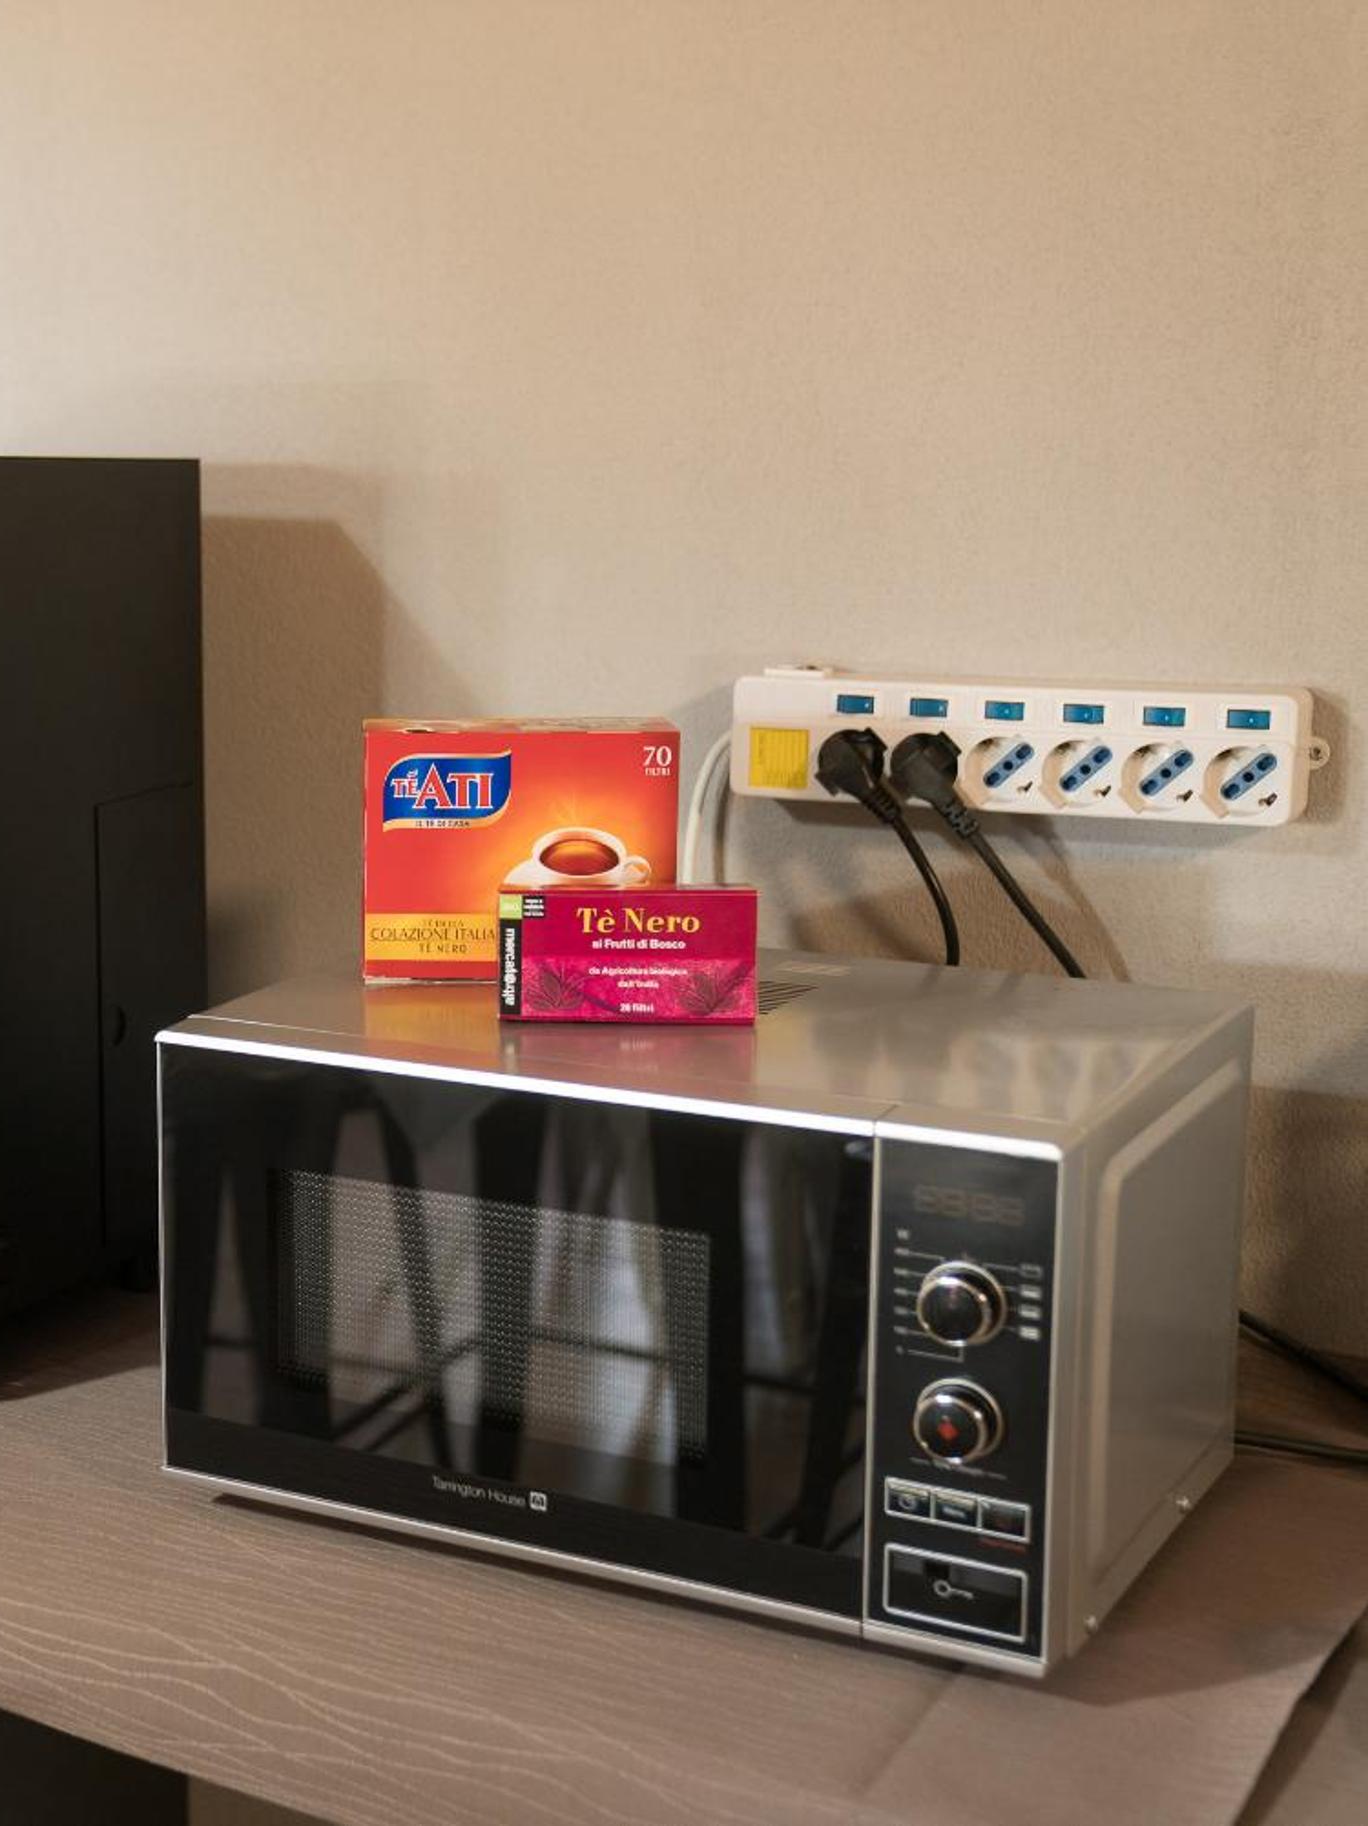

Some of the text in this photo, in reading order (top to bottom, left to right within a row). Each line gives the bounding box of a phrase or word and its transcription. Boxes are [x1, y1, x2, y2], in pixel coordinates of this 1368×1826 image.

[643, 745, 672, 767] 70
[412, 762, 494, 809] ATI
[576, 907, 616, 934] Tè
[622, 907, 700, 934] Nero
[604, 938, 635, 949] Frutti
[636, 938, 648, 949] di
[650, 939, 687, 949] Bosco
[488, 1488, 527, 1508] House
